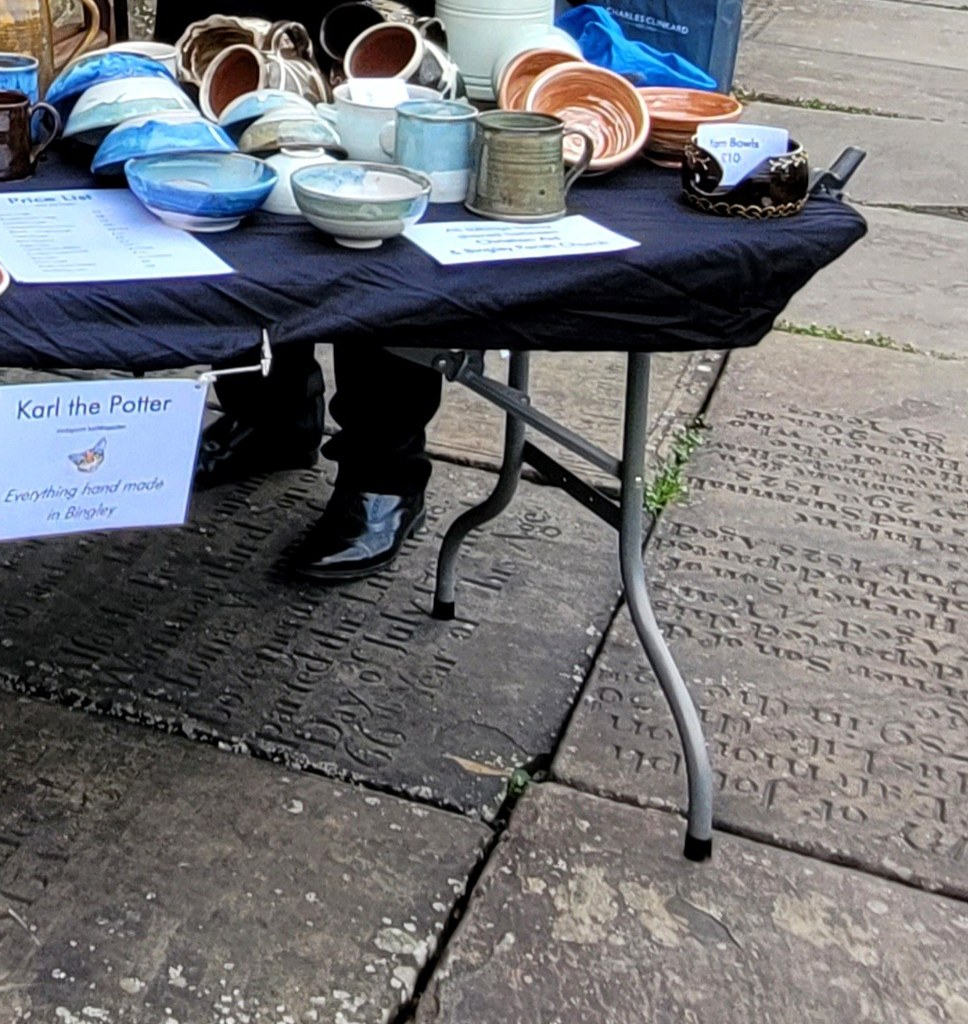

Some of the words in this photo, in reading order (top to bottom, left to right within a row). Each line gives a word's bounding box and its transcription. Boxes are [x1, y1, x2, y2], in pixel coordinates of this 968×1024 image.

[606, 7, 645, 23] CHARLES
[645, 17, 689, 34] CLINKARD
[729, 137, 759, 148] Bowls
[17, 396, 61, 420] Karl
[68, 399, 100, 417] the
[110, 395, 172, 415] Potter
[4, 483, 78, 504] Everything
[82, 479, 119, 497] hand
[124, 477, 165, 492] made
[47, 508, 60, 521] in
[64, 503, 117, 521] Bingley
